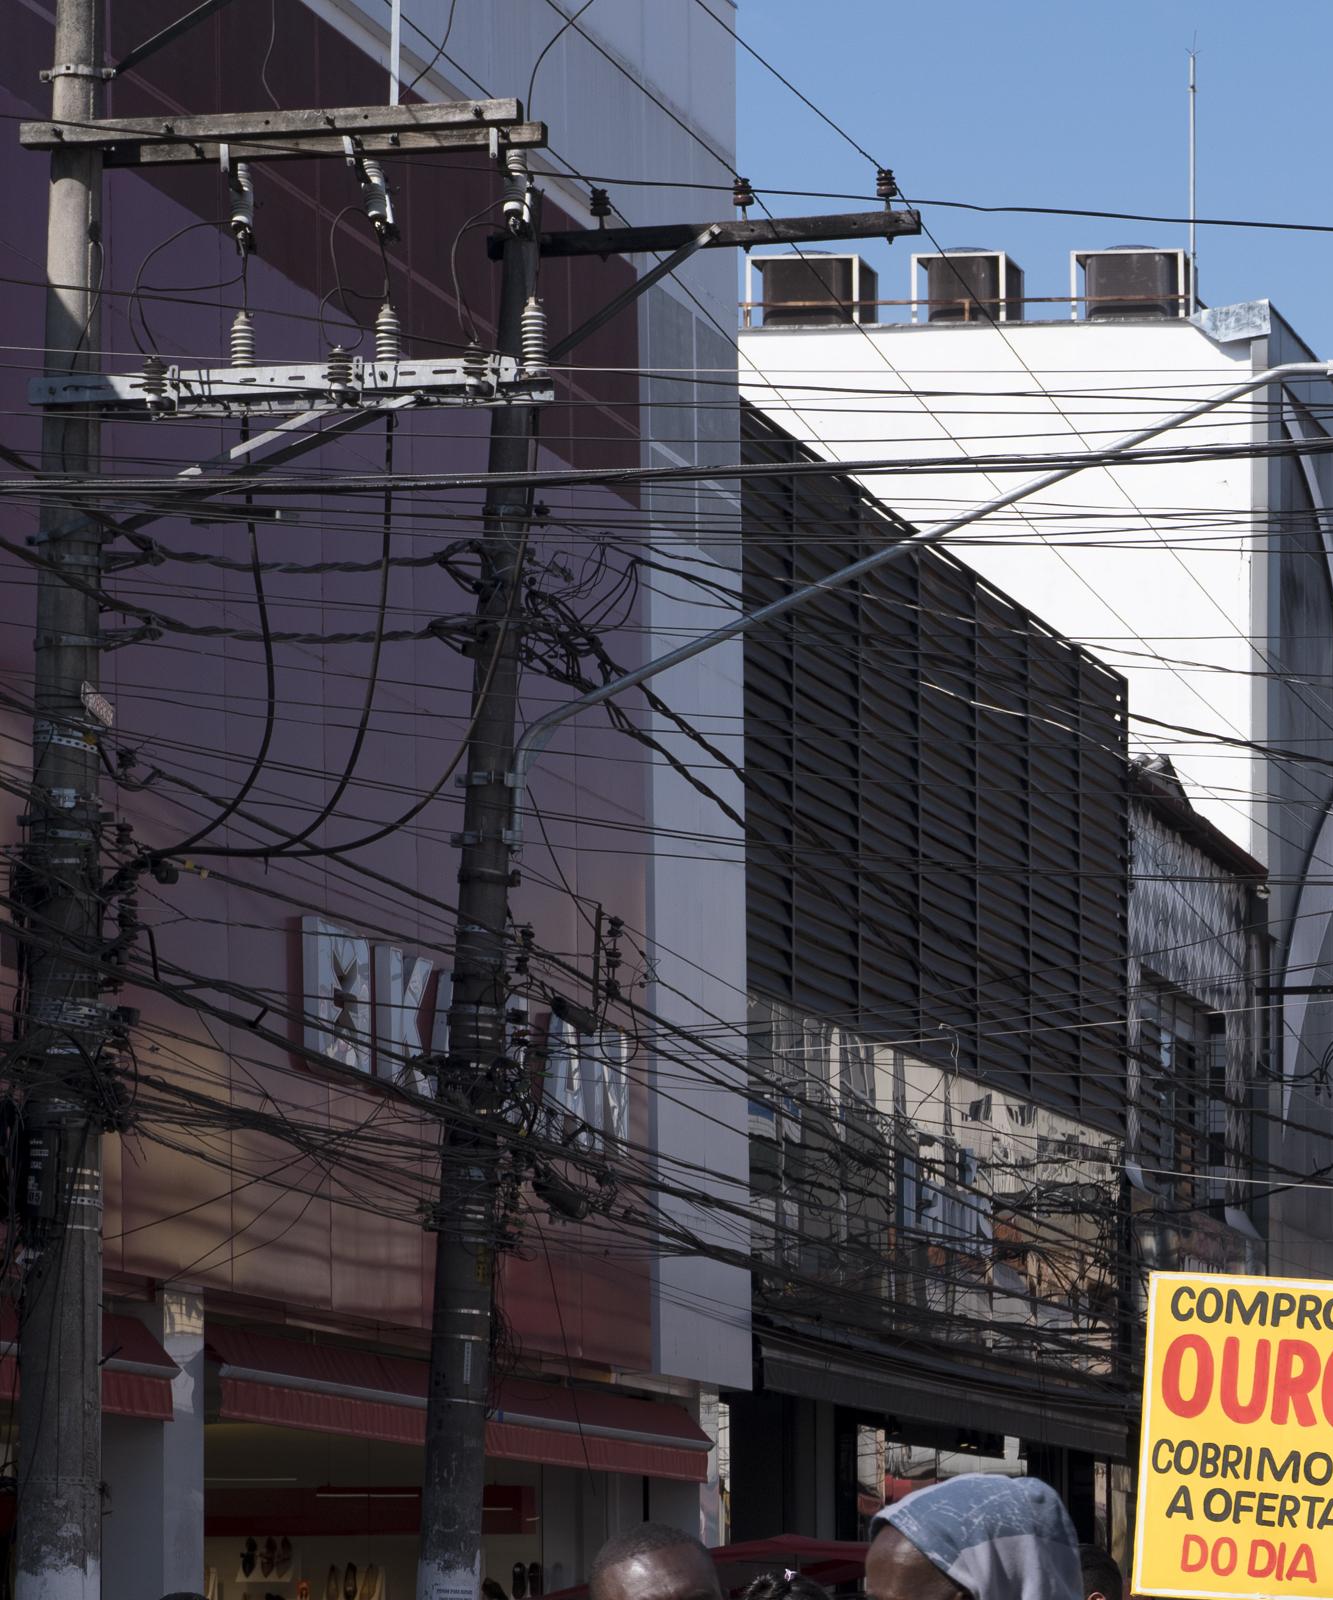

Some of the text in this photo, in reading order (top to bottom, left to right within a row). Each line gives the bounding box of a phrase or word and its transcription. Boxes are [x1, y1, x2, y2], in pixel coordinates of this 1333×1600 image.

[1165, 1485, 1194, 1521] A
[1180, 1534, 1317, 1583] DO DIA
